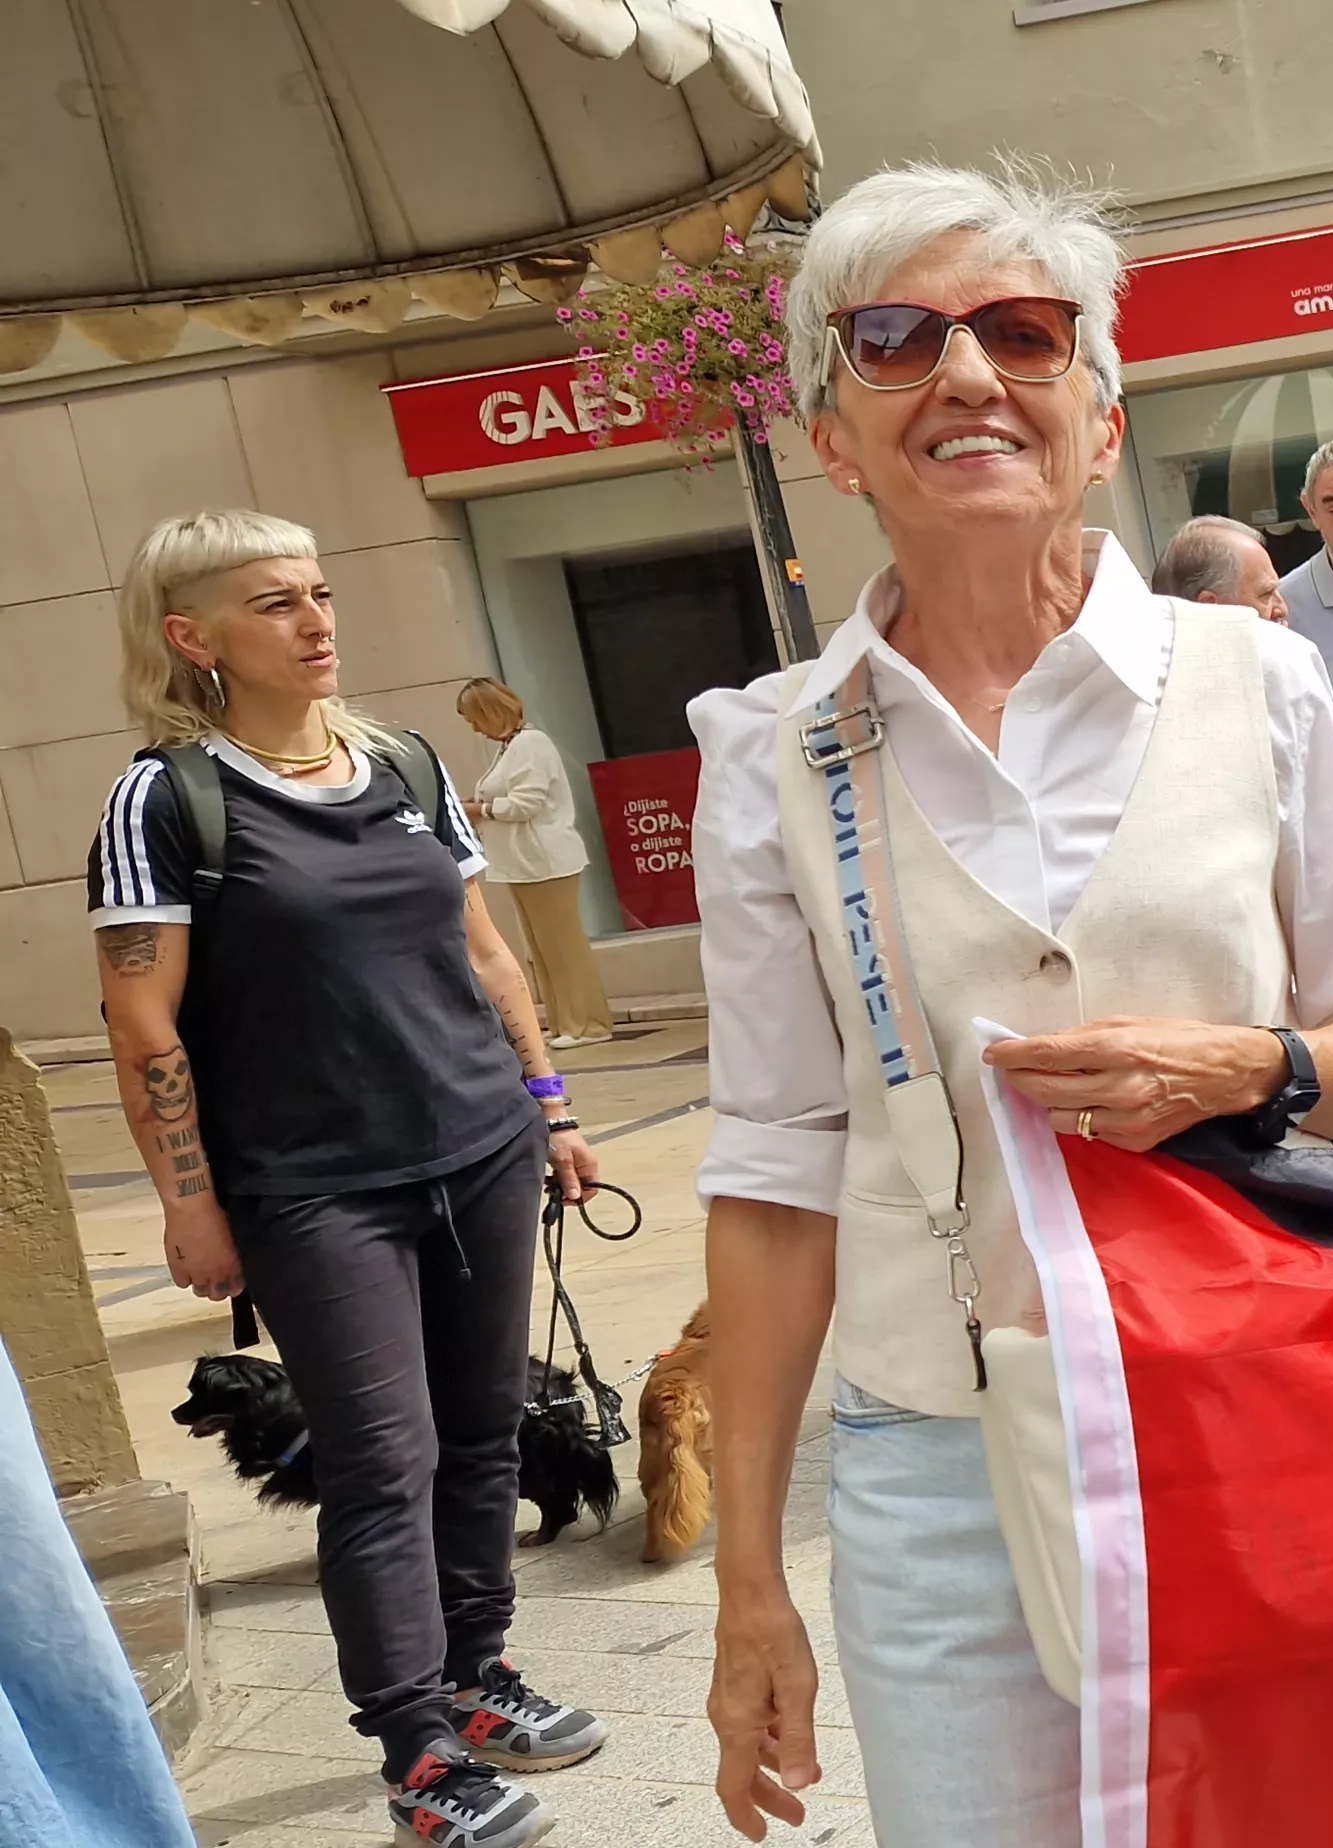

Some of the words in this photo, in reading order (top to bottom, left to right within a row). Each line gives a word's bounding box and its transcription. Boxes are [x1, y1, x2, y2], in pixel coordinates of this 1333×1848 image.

[1290, 287, 1311, 298] una
[623, 798, 669, 817] ¿Dijiste
[626, 812, 691, 837] SOPA,
[630, 843, 639, 852] o
[642, 836, 683, 852] dijiste
[635, 850, 695, 875] ROPA
